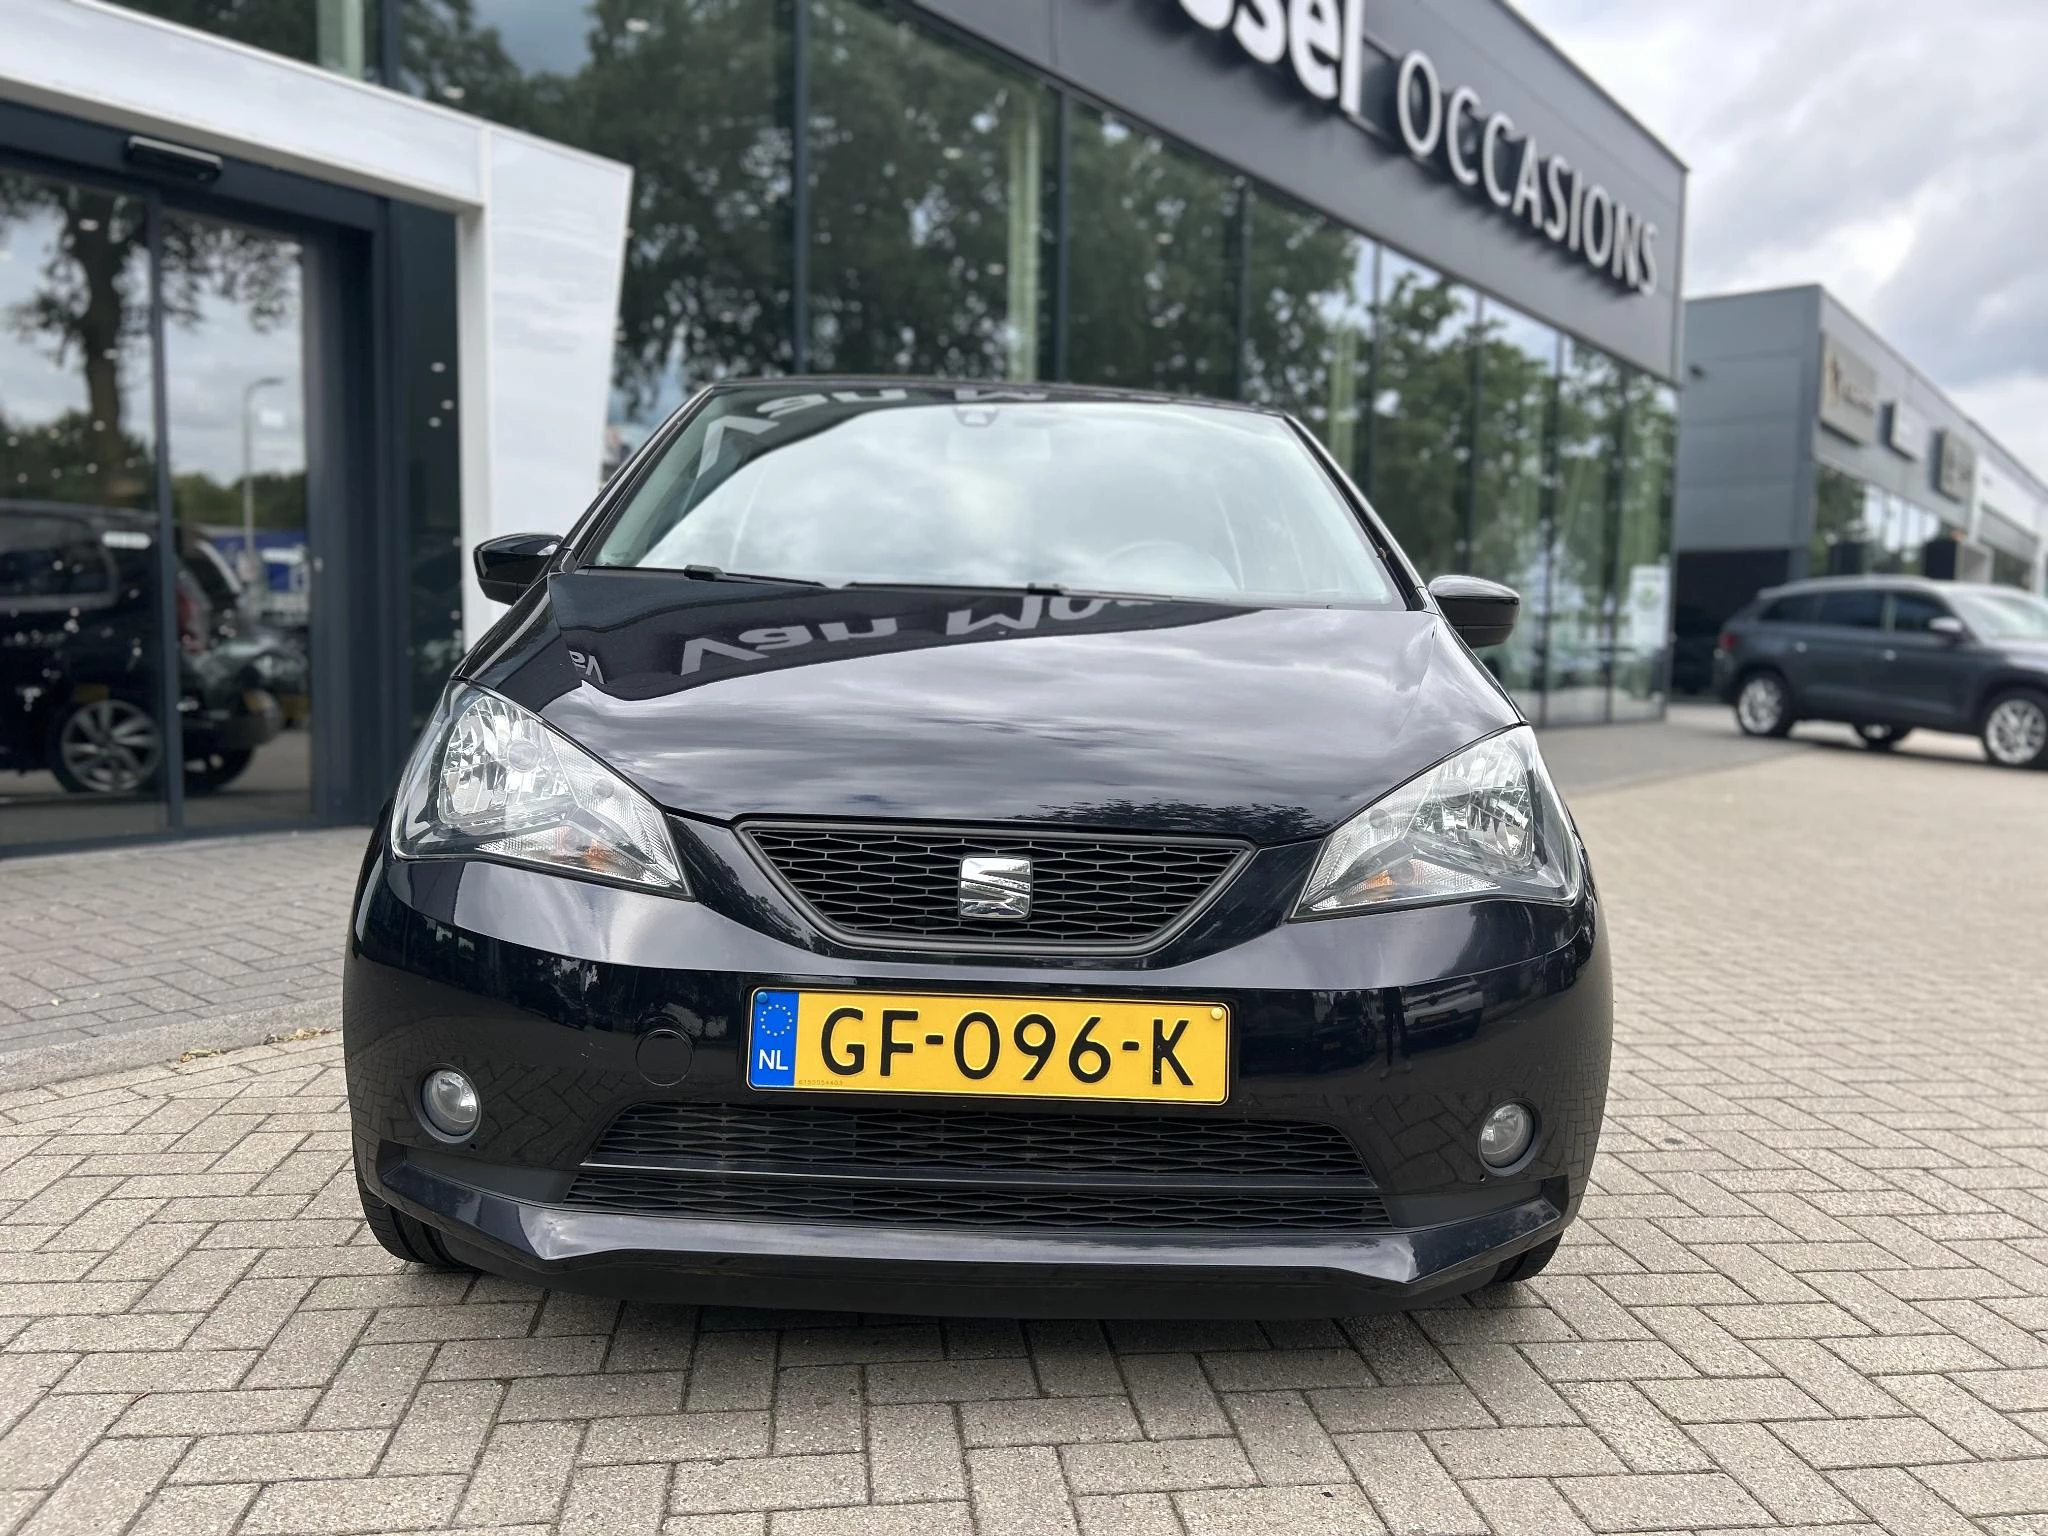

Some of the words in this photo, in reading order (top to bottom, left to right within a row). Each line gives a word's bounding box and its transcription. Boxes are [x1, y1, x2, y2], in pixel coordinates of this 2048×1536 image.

[1397, 50, 1658, 295] OCCASIONS
[757, 1048, 789, 1072] NL
[820, 1006, 1195, 1086] GF-096-K
